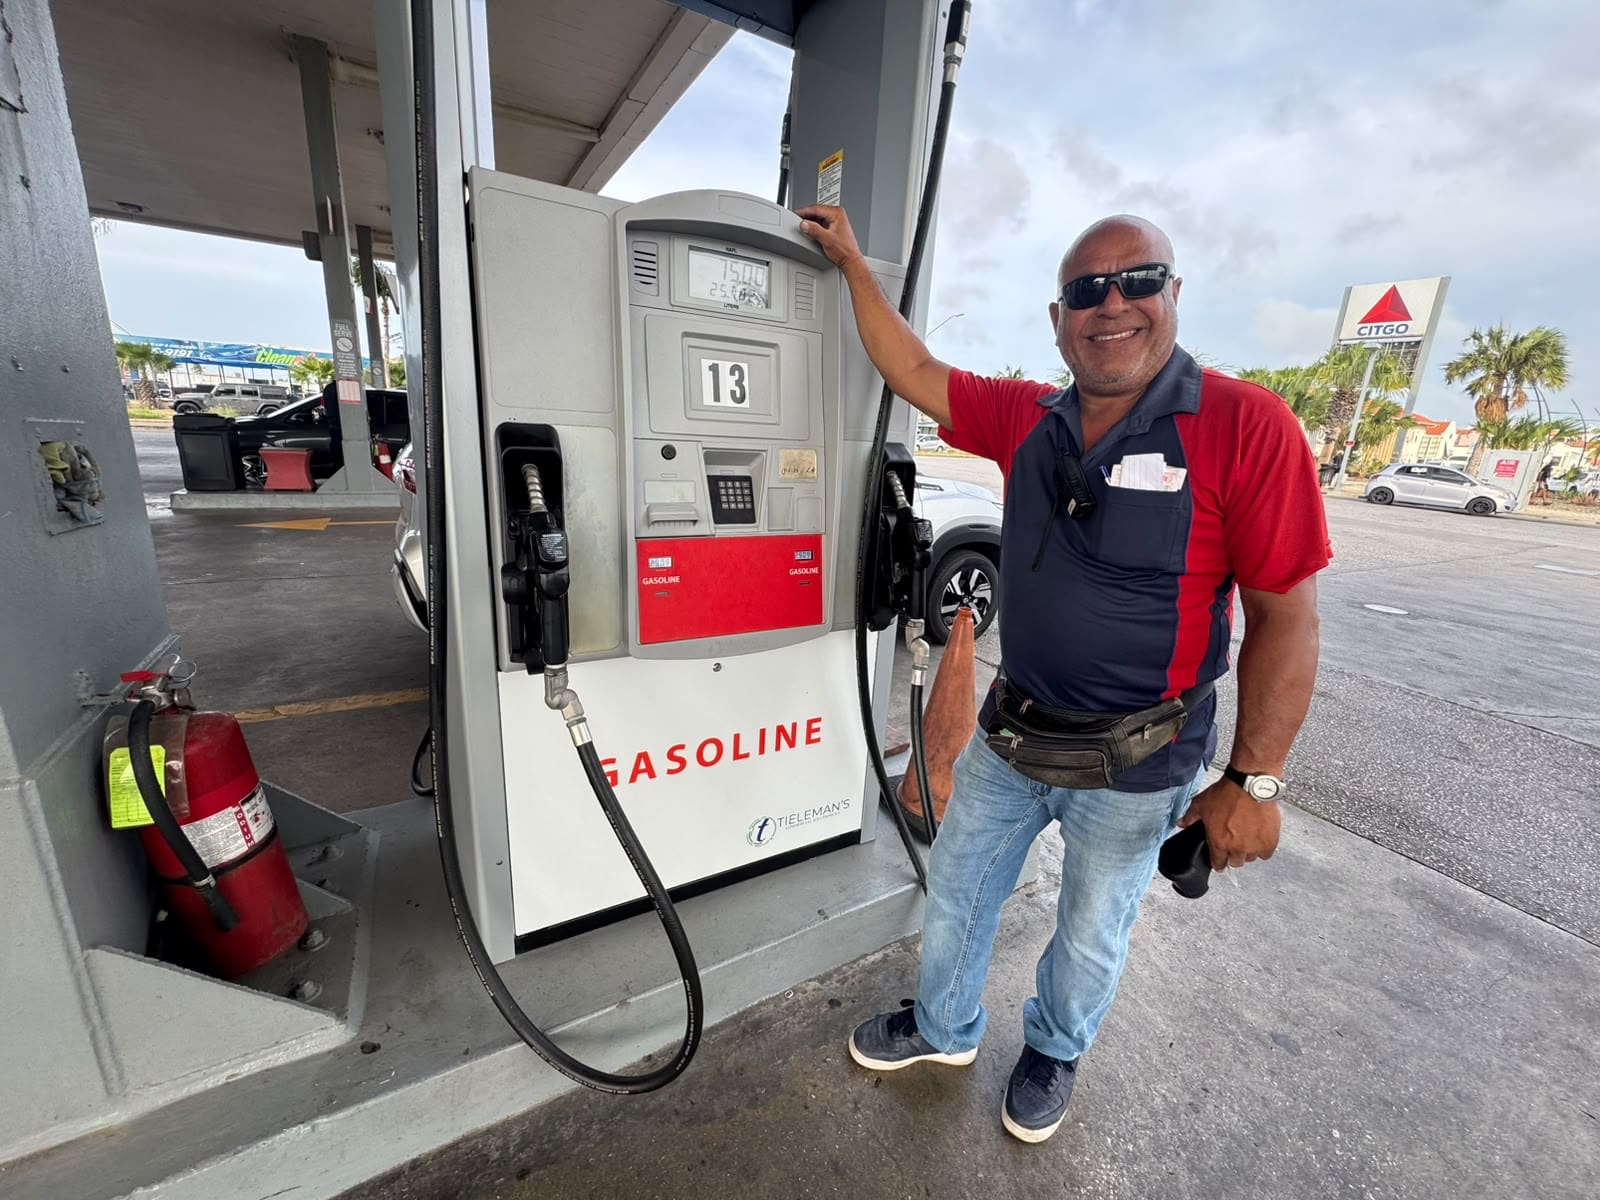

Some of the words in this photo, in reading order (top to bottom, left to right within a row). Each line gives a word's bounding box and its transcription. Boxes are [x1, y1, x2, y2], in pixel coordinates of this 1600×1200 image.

[1357, 323, 1409, 336] CITGO
[708, 362, 746, 405] 13
[642, 576, 681, 584] GASOLINE
[789, 567, 819, 575] GASOLINE
[600, 717, 822, 787] GASOLINE
[777, 799, 851, 828] TIELEMAN'S
